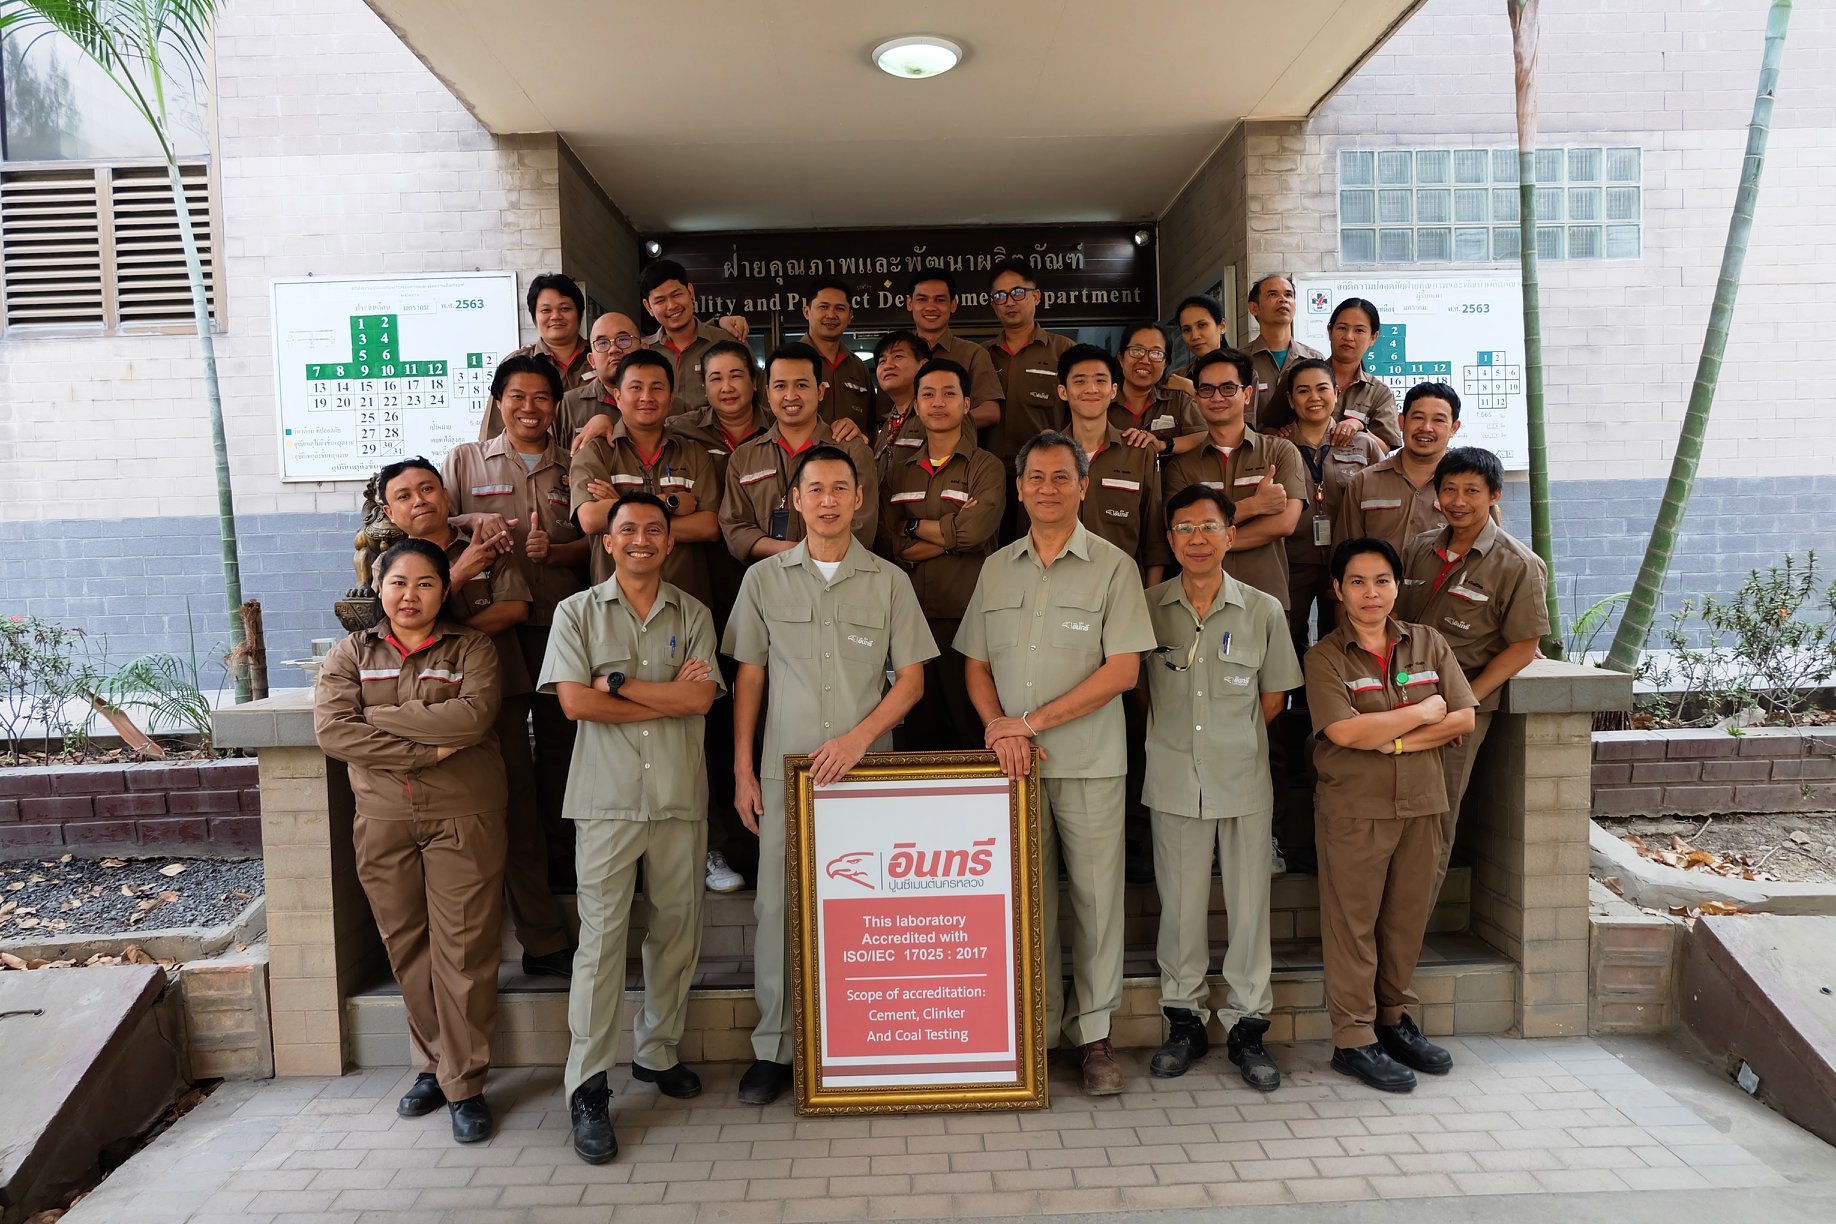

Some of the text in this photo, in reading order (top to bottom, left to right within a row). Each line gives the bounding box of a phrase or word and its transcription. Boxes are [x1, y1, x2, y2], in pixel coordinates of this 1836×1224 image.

[724, 242, 1084, 285] ฝ่ายคุณภาพและพัฒนาผิภัณฑ์
[456, 299, 484, 310] 2563
[744, 293, 781, 312] and
[1044, 287, 1142, 308] partment
[1462, 304, 1490, 313] 2563
[358, 317, 389, 329] 1 2
[359, 333, 388, 344] 3 4
[359, 349, 390, 360] 5 6
[472, 356, 492, 365] 1 2
[313, 364, 442, 377] 7 8 9 10 11 12
[458, 373, 464, 381] 3
[487, 371, 493, 380] 5
[314, 380, 443, 392] 13 14 15 16 17 18
[459, 386, 464, 395] 7
[315, 395, 444, 408] 19 20 21 22 23 24
[472, 401, 480, 409] 11
[361, 412, 398, 423] 25 26
[362, 428, 398, 438] 27 28
[362, 444, 376, 454] 29
[888, 838, 996, 879] อินทรี
[888, 878, 984, 892] ปูนซีเมนต์นครหลวง
[863, 914, 966, 928] This laboratory
[862, 931, 968, 945] Accredited with
[843, 950, 895, 963] ISO/IEC
[904, 948, 944, 960] 17025
[956, 947, 987, 960] 2017
[847, 986, 986, 1003] Scope of accreditation:
[869, 1008, 966, 1022] Cement, Clinker
[867, 1028, 968, 1042] And Coal Testing
